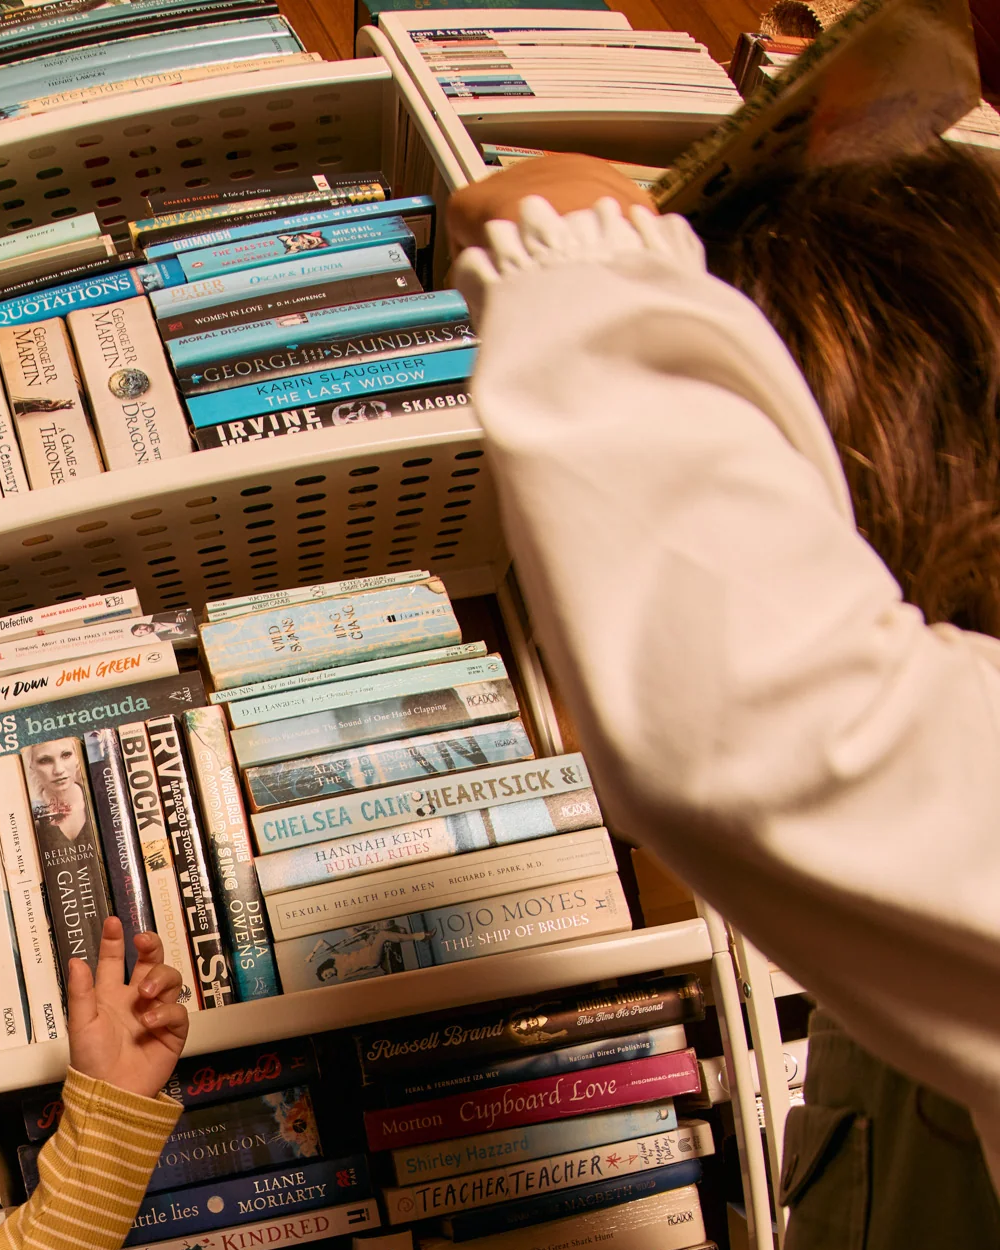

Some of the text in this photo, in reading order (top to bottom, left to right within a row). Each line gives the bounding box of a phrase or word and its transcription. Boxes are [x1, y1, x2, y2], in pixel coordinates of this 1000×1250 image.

[40, 13, 88, 30] JUNGLE
[47, 70, 106, 88] HENRY LAWSON
[164, 193, 219, 205] CHARLES DICKENS
[173, 230, 231, 251] GRIMMISH
[195, 304, 263, 325] WOMEN IN LOVE
[309, 294, 435, 318] MARGARET ATWOOD
[92, 310, 122, 369] MARTIN
[112, 308, 130, 348] GEORGE
[178, 321, 272, 345] MORAL DISORDER
[331, 329, 453, 359] SAUNDERS
[13, 330, 41, 387] MARTIN
[33, 327, 51, 368] GEORGE
[202, 354, 300, 383] GEORGE
[257, 359, 426, 395] KARIN SLAUGHTER
[265, 371, 425, 407] THE LAST WIDOW
[216, 407, 321, 441] IRVINE
[0, 445, 19, 493] Century
[0, 614, 34, 631] Defective
[13, 677, 48, 697] DOWN
[55, 654, 141, 687] JOHN GREEN
[25, 696, 150, 736] barracuda
[122, 734, 164, 831] BLOCK
[424, 769, 554, 810] HEARTSICK
[263, 794, 415, 843] CHELSEA CAIN
[44, 843, 94, 860] BELINDA
[47, 852, 94, 867] ALEXANDRA
[315, 827, 434, 863] HANNAH KENT
[325, 841, 431, 874] BURIAL RITES
[246, 900, 268, 958] DELIA
[437, 889, 588, 942] JOJO MOYES
[230, 900, 255, 970] OWENS
[441, 914, 590, 953] THE SHIP OF BRIDES
[367, 1019, 504, 1061] Russell Brand
[460, 1076, 617, 1128] Cupboard Love
[382, 1115, 443, 1136] Morton
[406, 1136, 529, 1174] Shirley Hazzard
[238, 1184, 327, 1214] MORIARTY
[254, 1172, 306, 1194] LIANE
